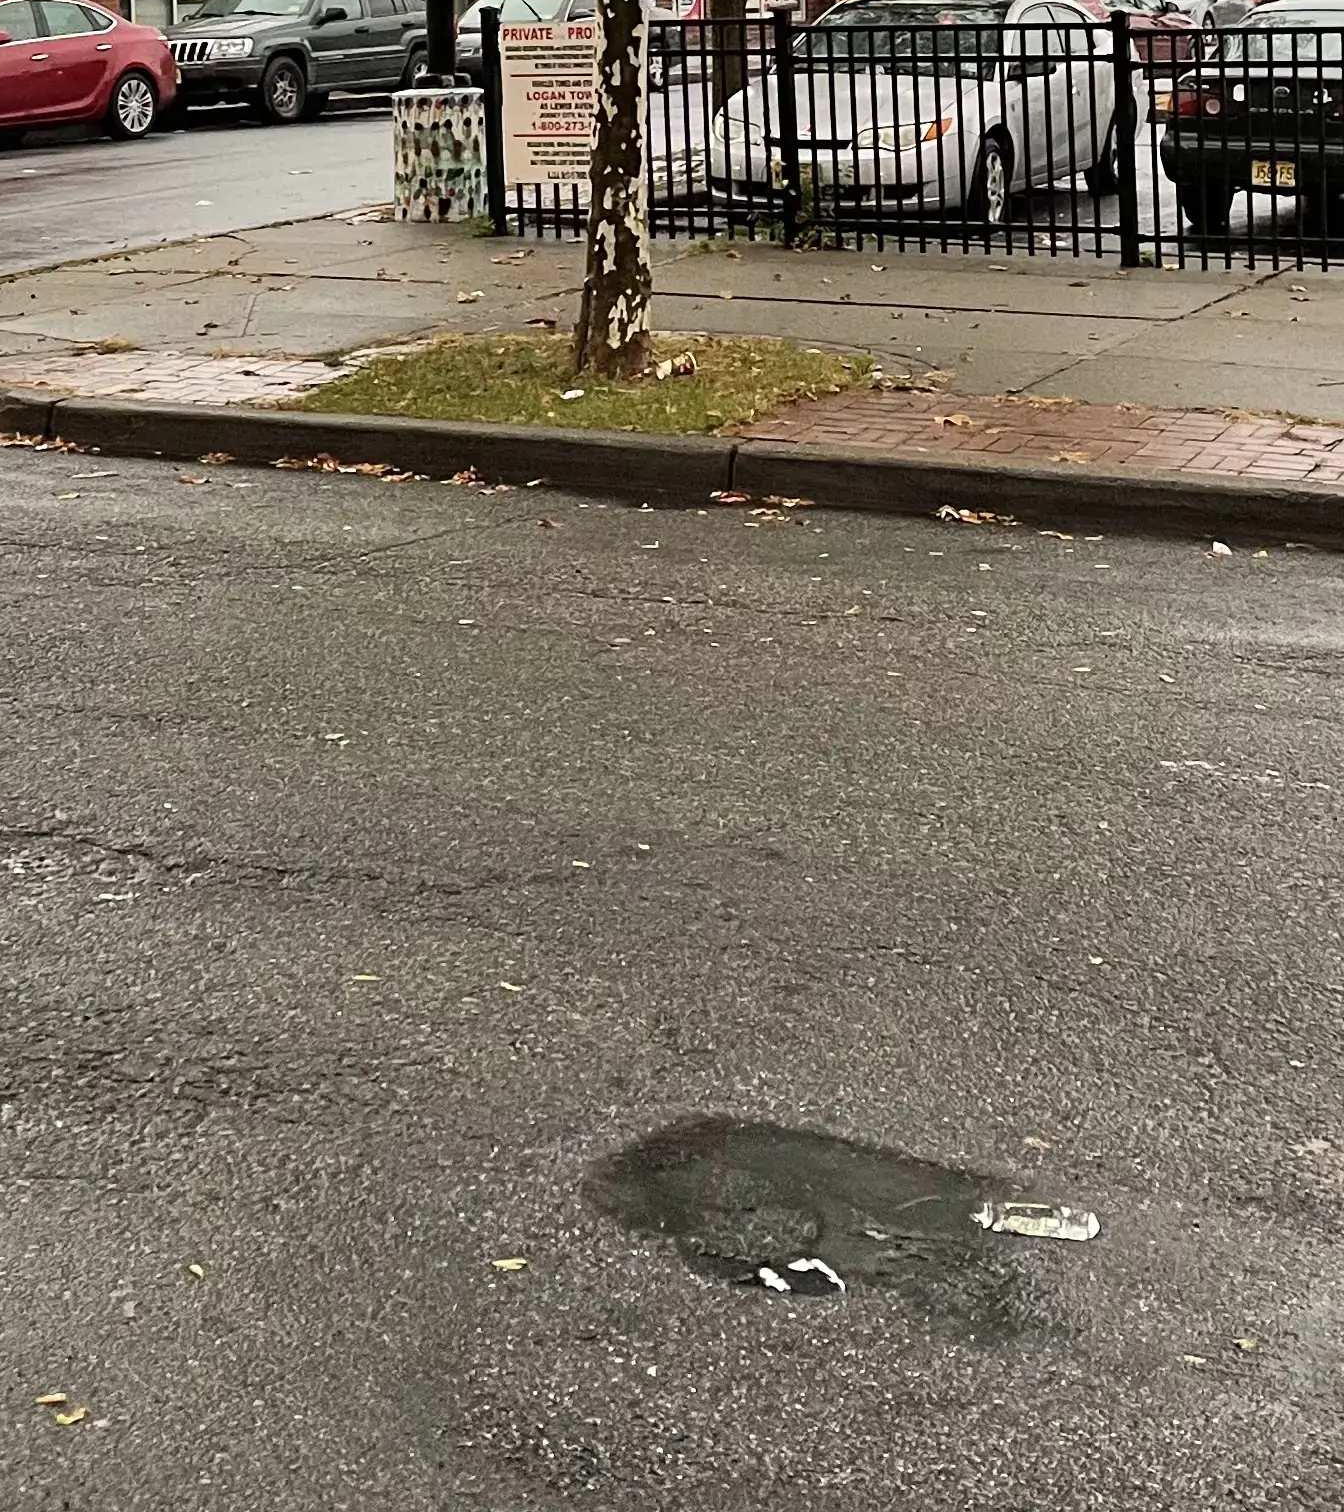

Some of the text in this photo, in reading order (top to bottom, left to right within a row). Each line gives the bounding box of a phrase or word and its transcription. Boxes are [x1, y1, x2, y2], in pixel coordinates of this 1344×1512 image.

[502, 26, 596, 41] PRIVATE PRO
[526, 91, 566, 101] LOGAN
[531, 121, 592, 132] 1-800-273-
